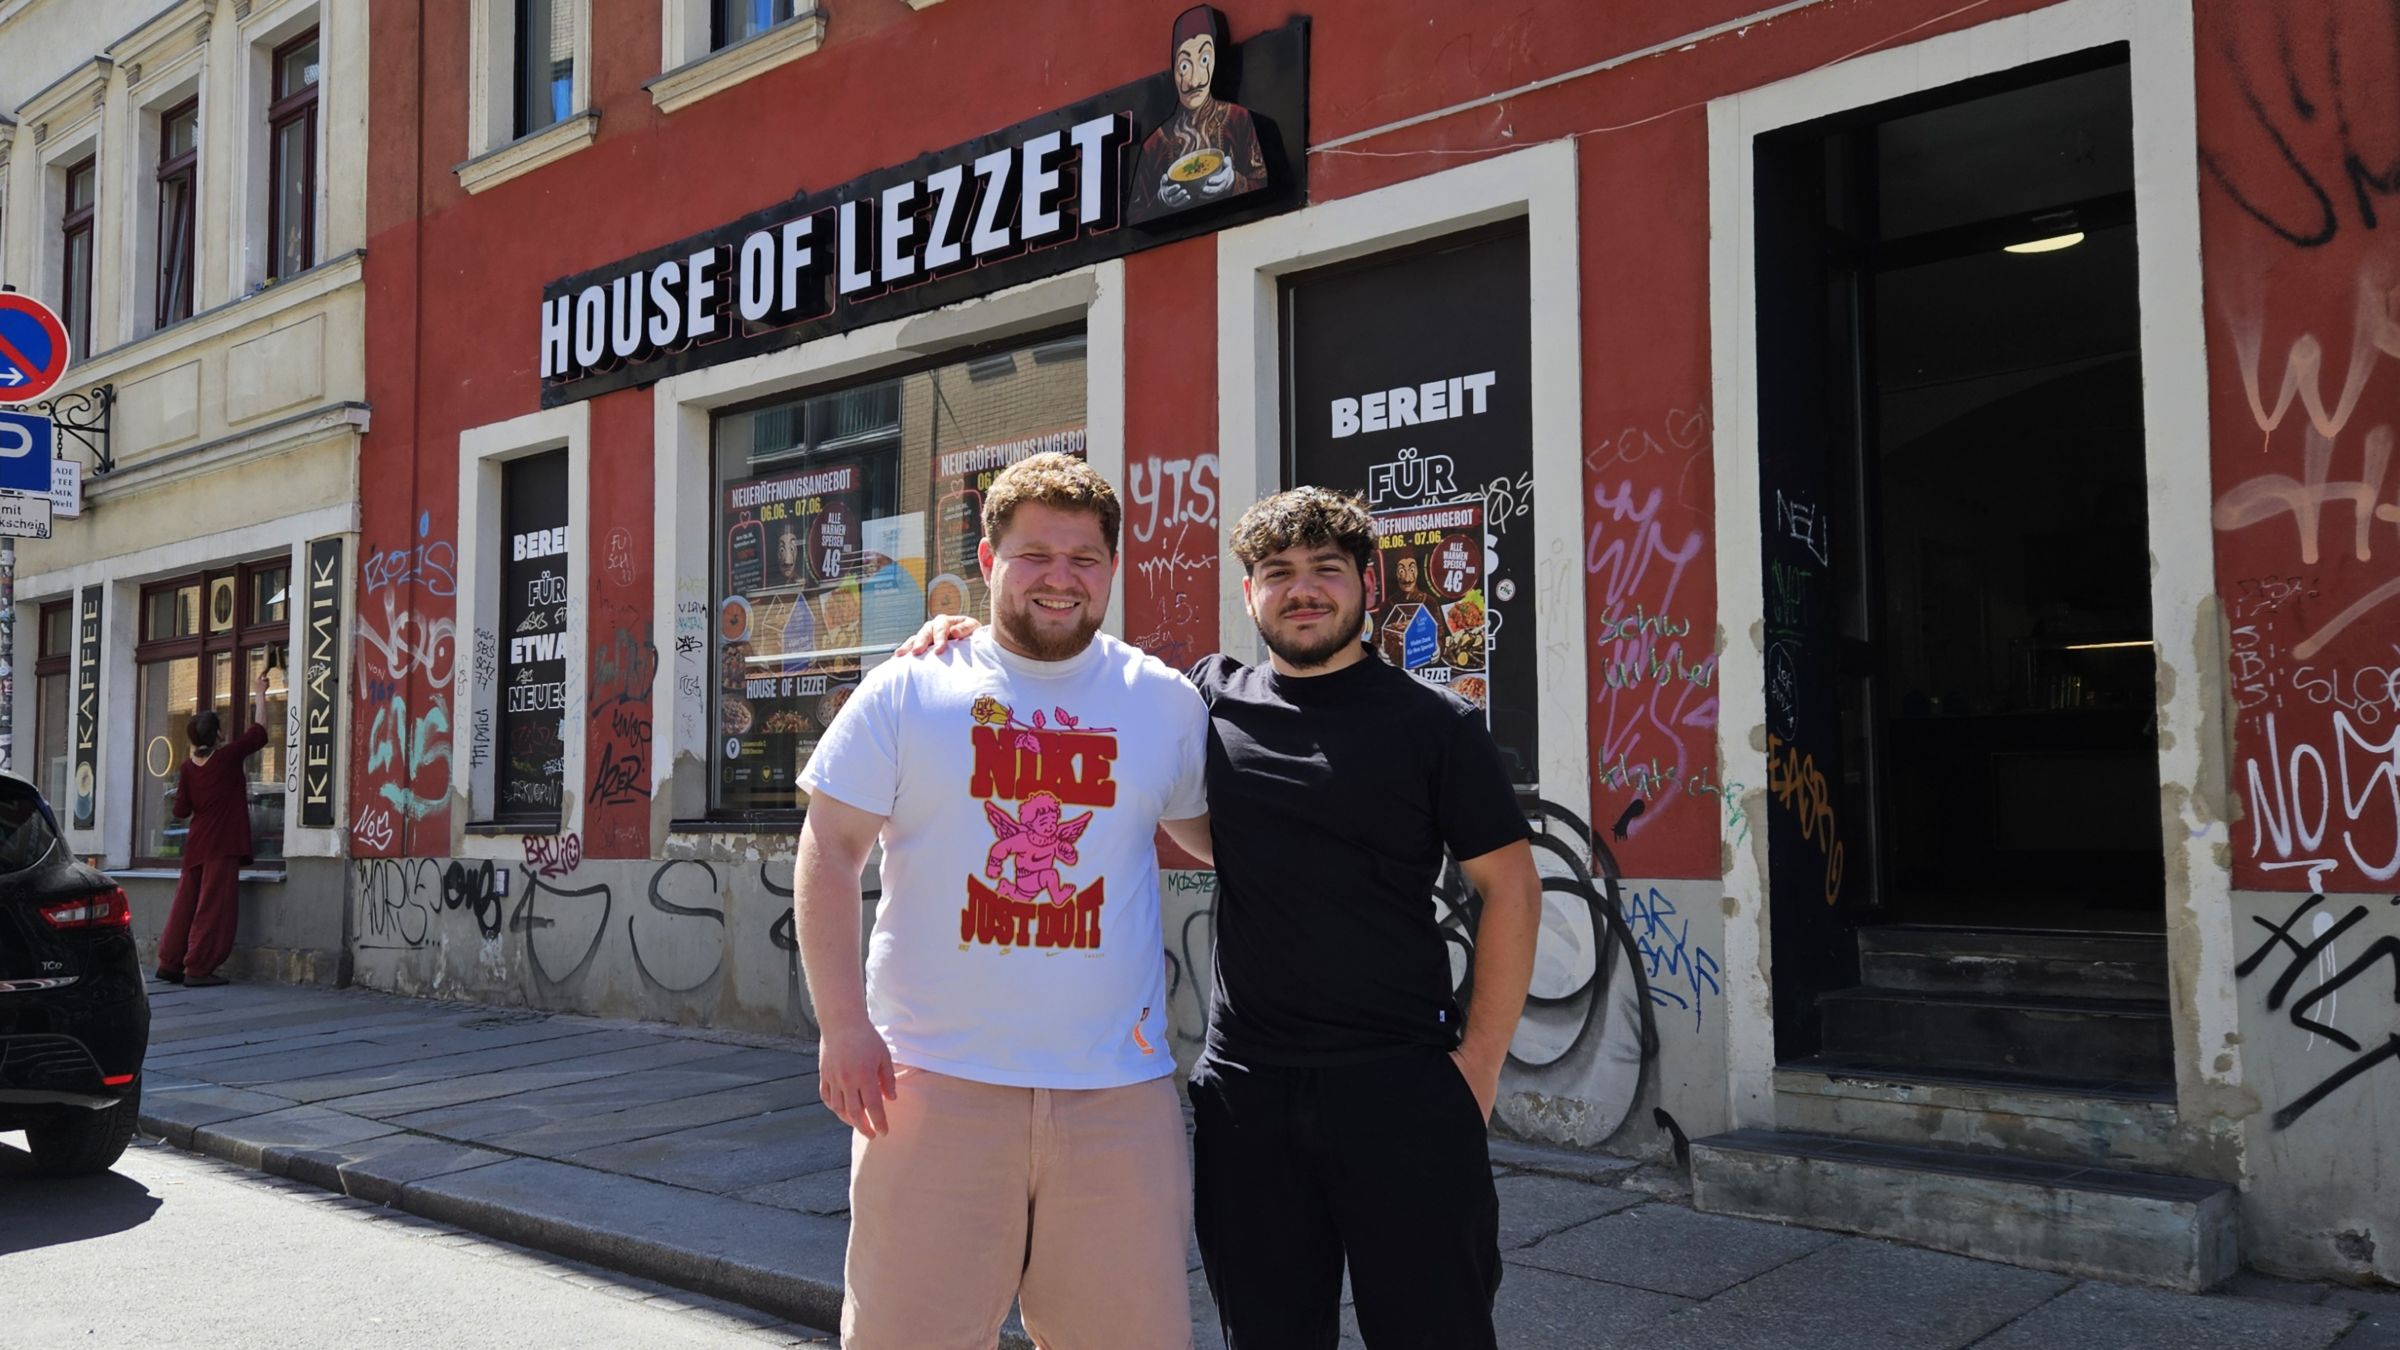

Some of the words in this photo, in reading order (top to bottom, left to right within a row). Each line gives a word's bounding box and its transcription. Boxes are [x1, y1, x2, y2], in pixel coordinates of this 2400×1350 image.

[540, 253, 717, 380] HOUSE
[739, 216, 812, 322] OF
[838, 113, 1116, 295] LEZZET
[1331, 370, 1496, 439] BEREIT
[53, 467, 73, 476] ADE
[731, 468, 852, 509] NEUERÖFFNUNGSANGEBOT
[1368, 447, 1457, 504] FÜR
[1, 504, 22, 516] mit
[51, 489, 73, 497] MIK
[827, 511, 842, 524] ALLE
[1378, 535, 1407, 550] 06.06.
[1414, 530, 1444, 546] 07.06.
[1449, 542, 1464, 552] ALLE
[528, 569, 567, 607] FÜR
[79, 599, 98, 750] KAFFEE
[306, 554, 335, 805] KERAMIK
[746, 678, 777, 699] HOUSE
[781, 677, 793, 697] OF
[796, 675, 828, 697] LEZZET
[969, 724, 1119, 808] NIKE
[961, 873, 1037, 947] JUST
[1035, 899, 1077, 949] DO
[1073, 876, 1105, 949] IT
